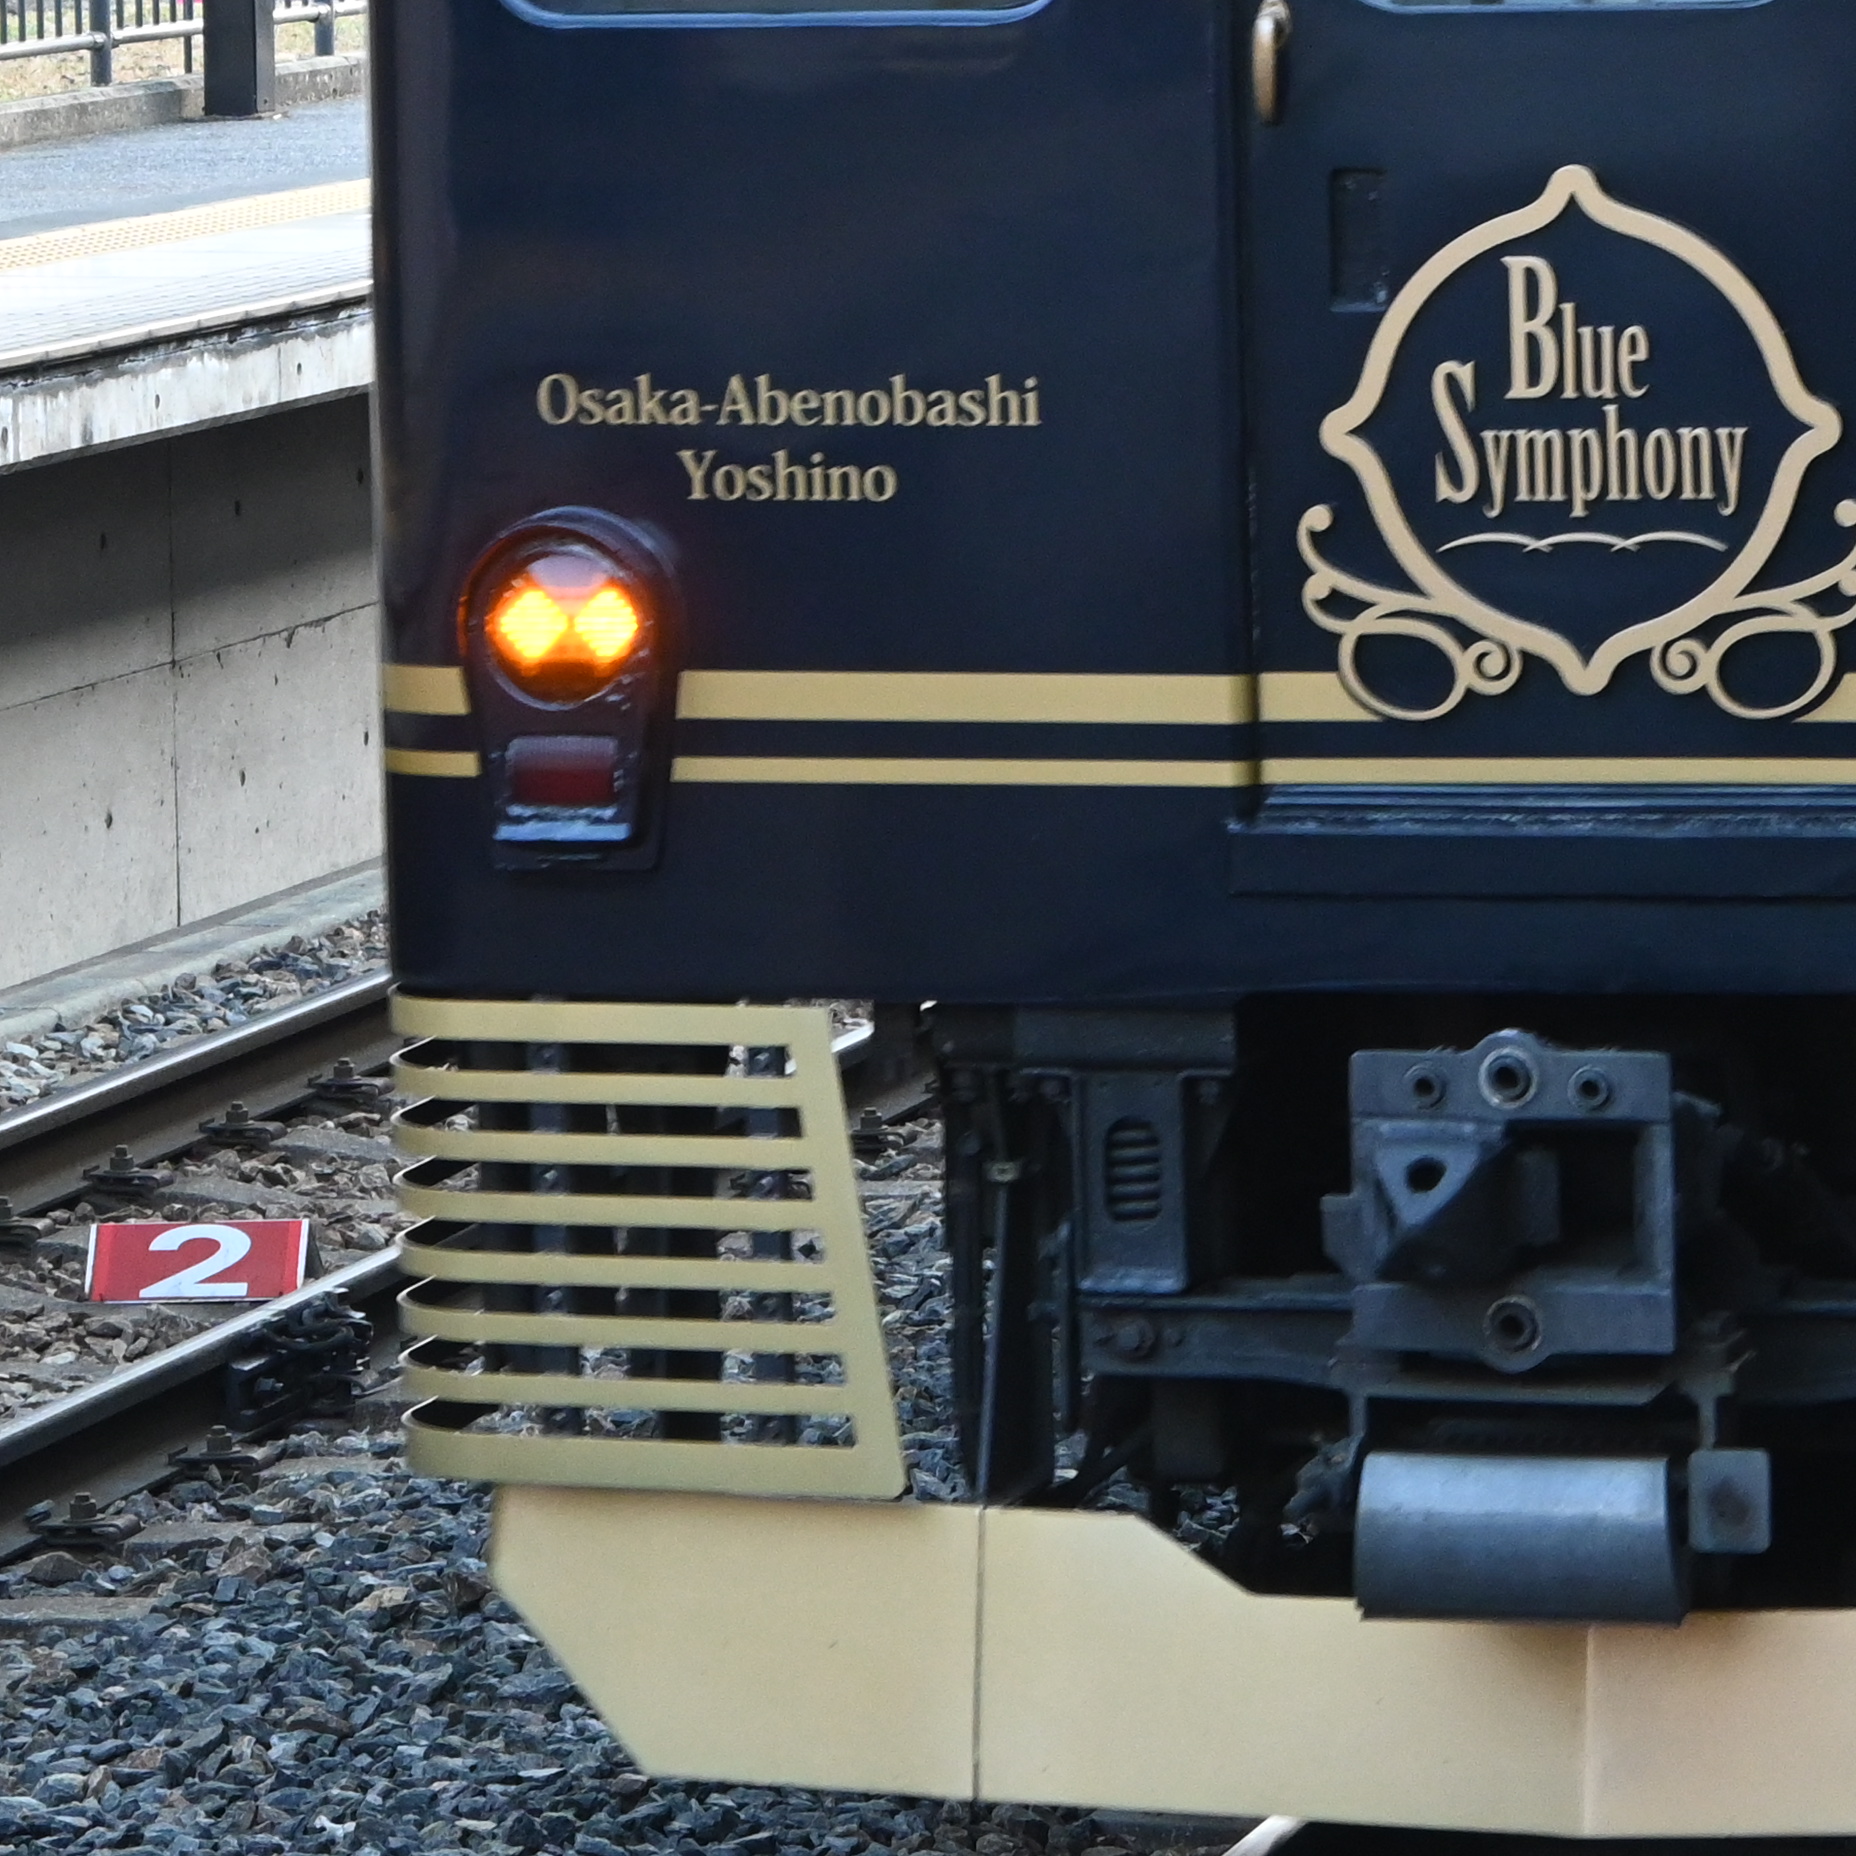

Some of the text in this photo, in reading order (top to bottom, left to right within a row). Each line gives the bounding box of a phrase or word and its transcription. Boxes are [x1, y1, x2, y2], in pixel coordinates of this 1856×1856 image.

[1500, 255, 1650, 400] Blue
[536, 372, 1042, 427] Osaka-Abenobashi
[676, 449, 898, 502] Yoshino
[1430, 360, 1748, 519] Symphony
[138, 1223, 252, 1298] 2
